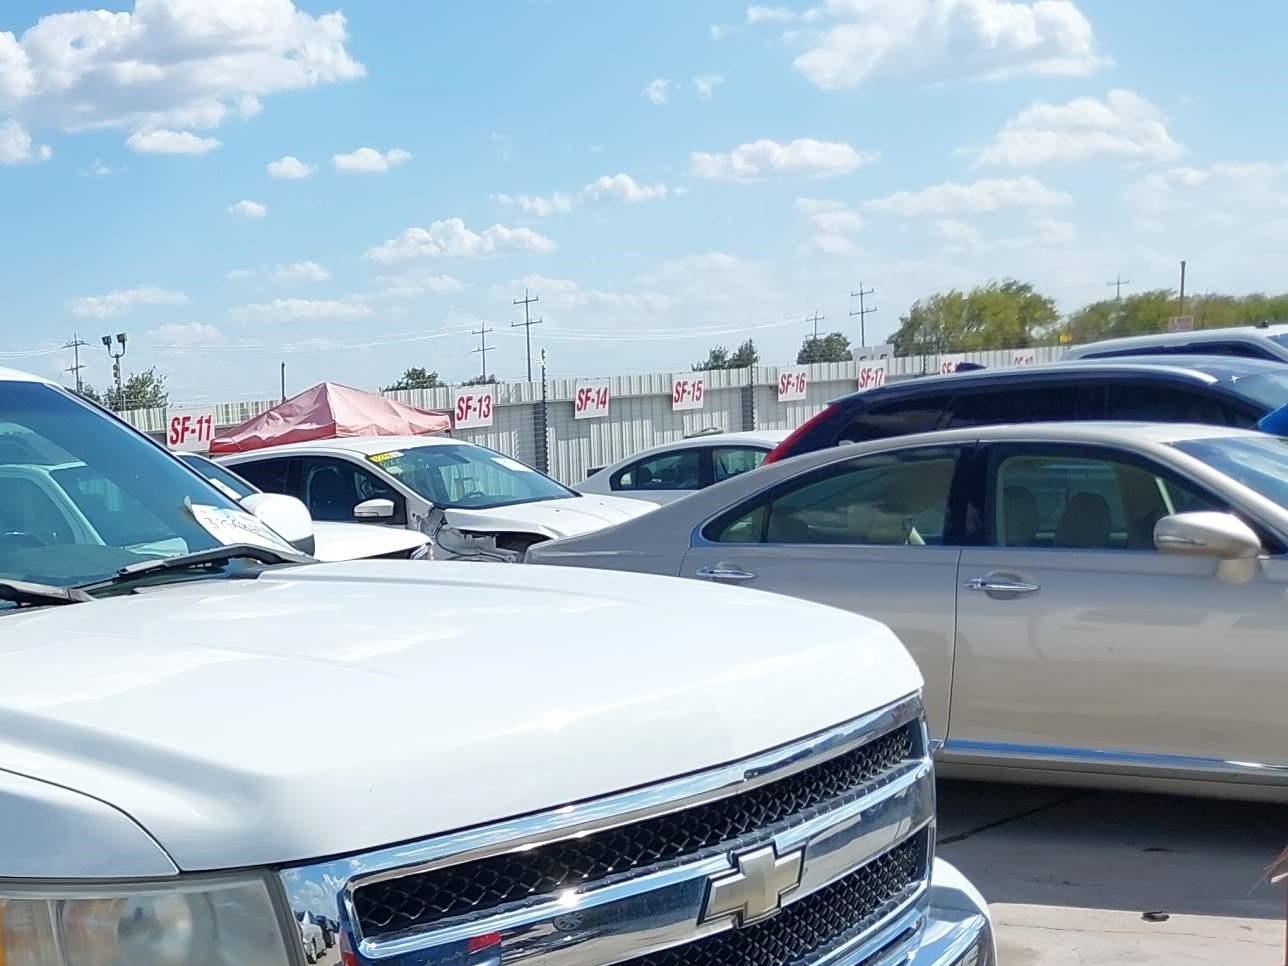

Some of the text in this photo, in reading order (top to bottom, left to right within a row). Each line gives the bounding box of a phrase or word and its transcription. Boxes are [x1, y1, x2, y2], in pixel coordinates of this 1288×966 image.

[779, 373, 807, 395] SF-16
[860, 368, 884, 388] SF-17
[577, 387, 608, 411] SF-14
[674, 379, 704, 403] SF-15
[456, 393, 492, 421] SF-13
[169, 415, 212, 445] SF-11
